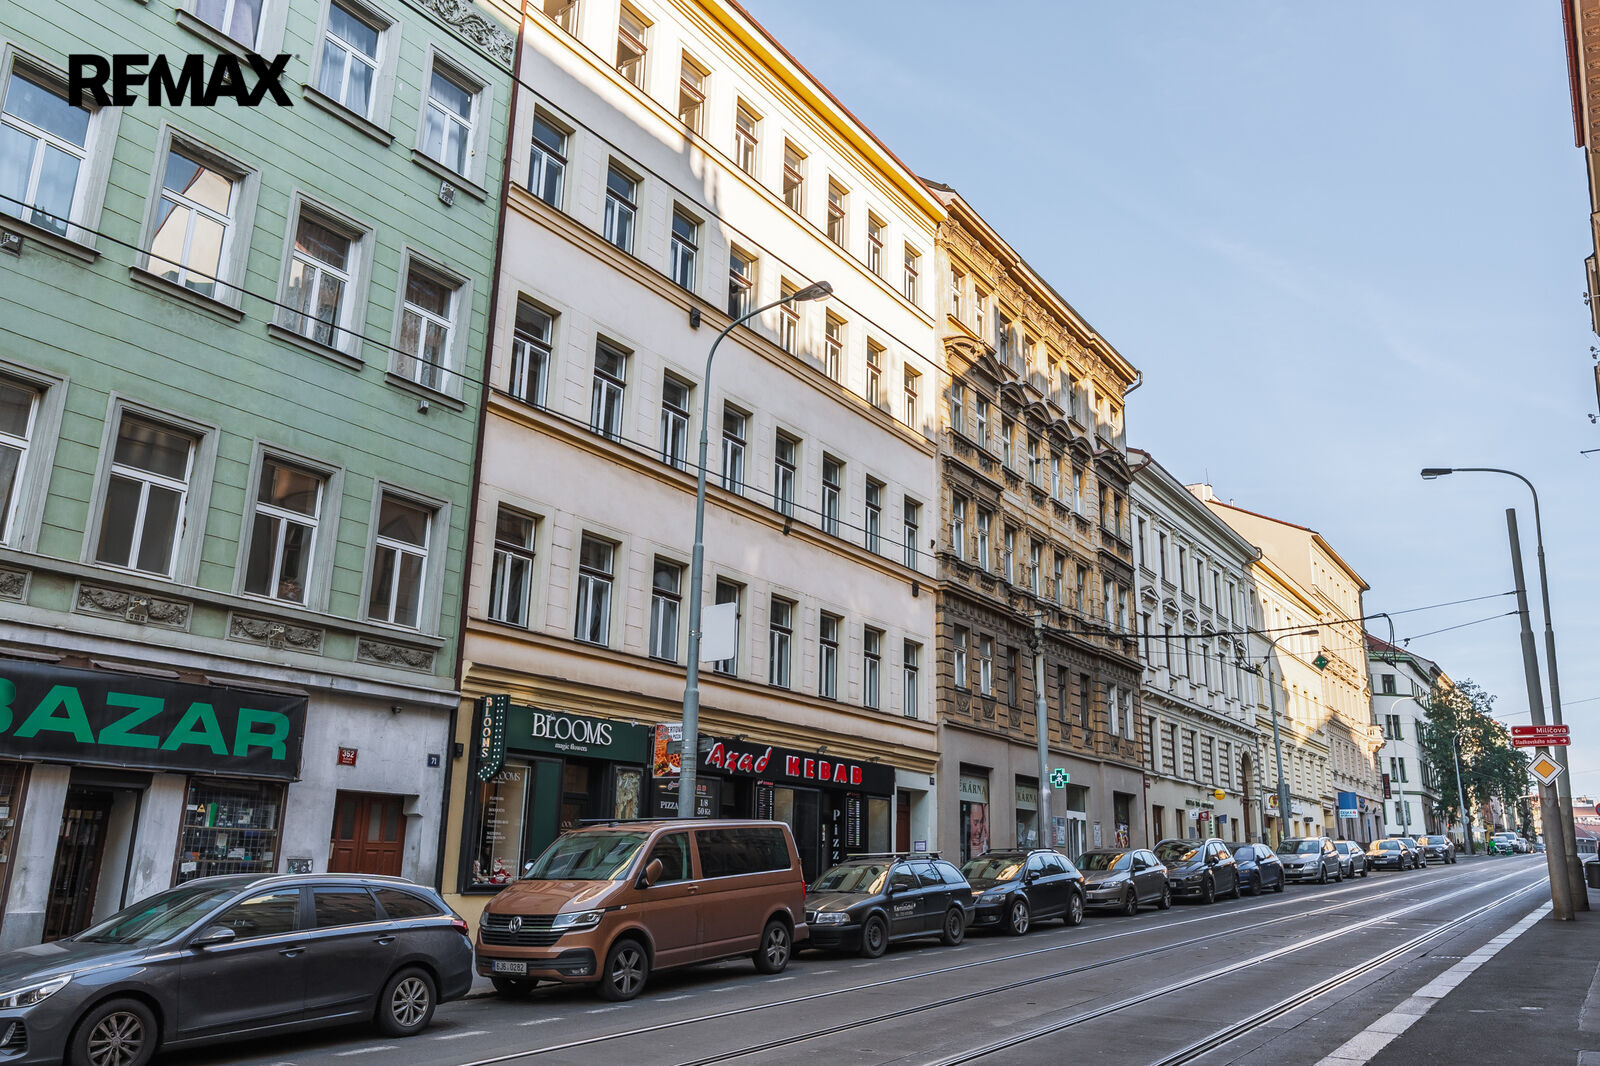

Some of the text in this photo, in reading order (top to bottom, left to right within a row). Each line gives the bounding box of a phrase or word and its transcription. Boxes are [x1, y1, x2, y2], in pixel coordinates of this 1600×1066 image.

[0, 677, 290, 761] AZAR
[481, 696, 493, 758] BLOOMS
[532, 713, 612, 745] BLOOMS
[342, 750, 354, 758] 352
[431, 757, 437, 765] 71
[705, 742, 862, 785] Azad KEBAB
